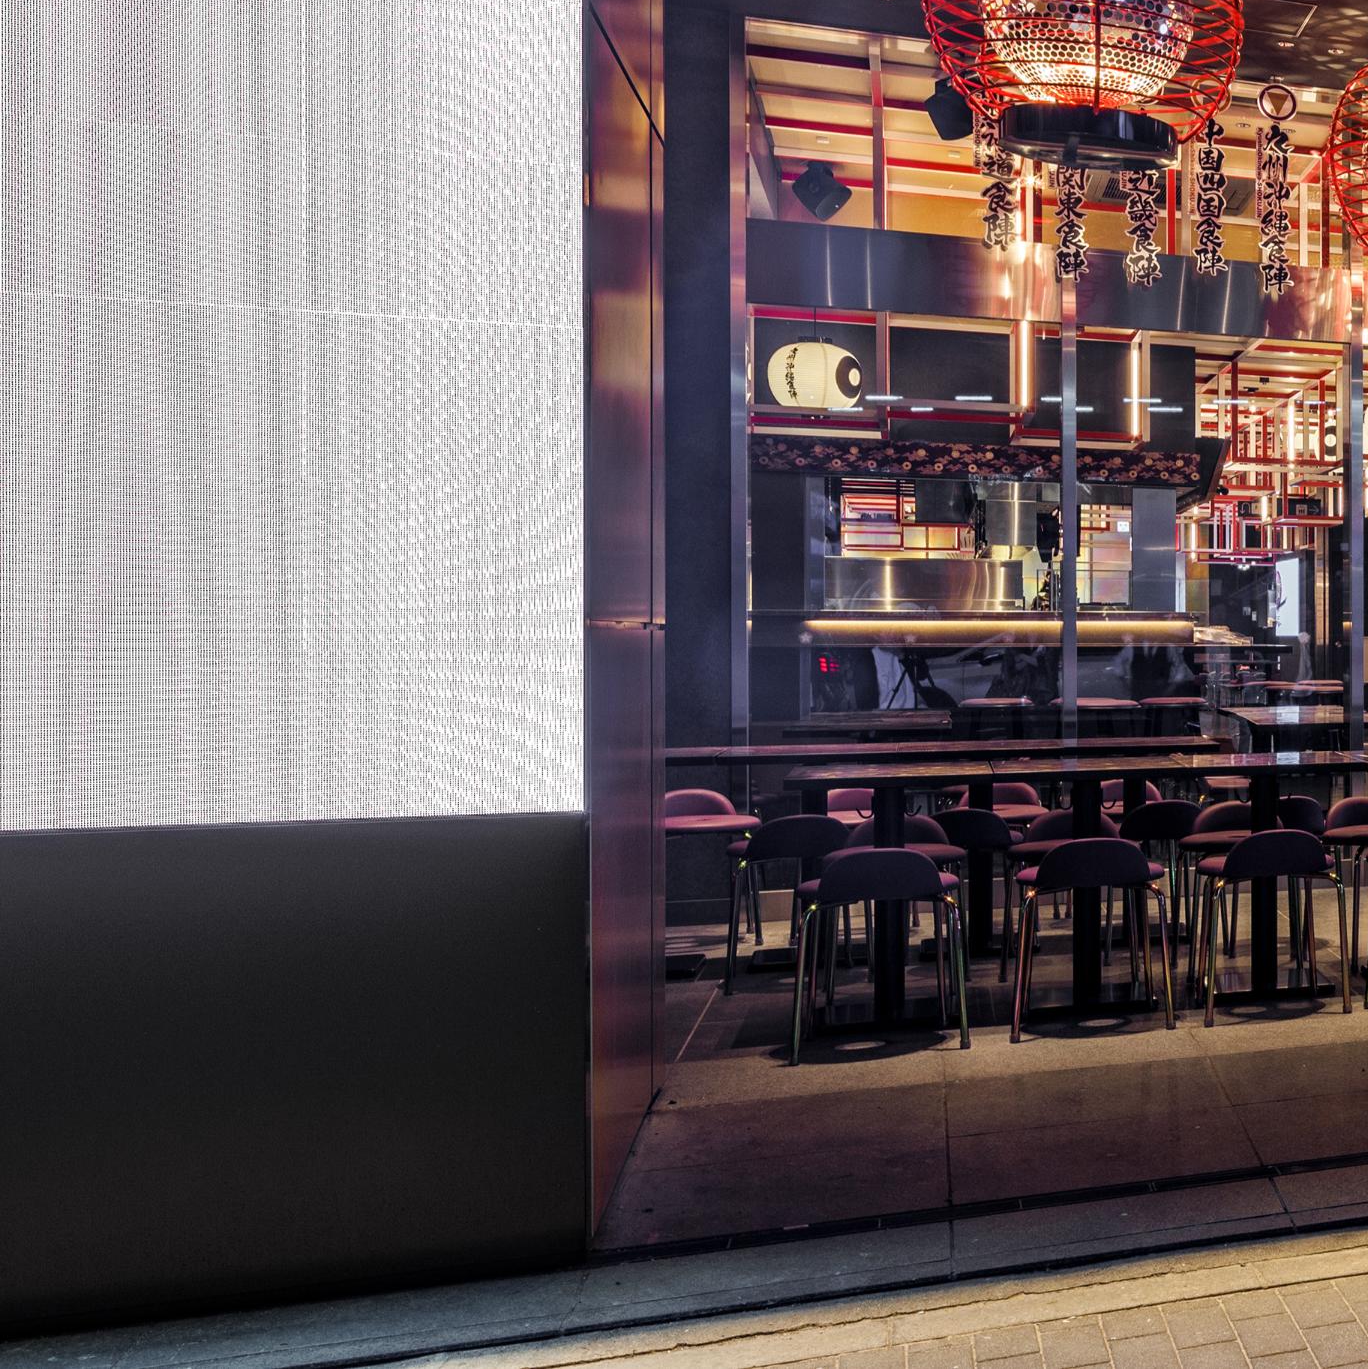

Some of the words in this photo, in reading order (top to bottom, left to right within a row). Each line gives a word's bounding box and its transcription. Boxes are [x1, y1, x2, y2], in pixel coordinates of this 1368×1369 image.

[1260, 123, 1294, 294] 九州沖縄食陣
